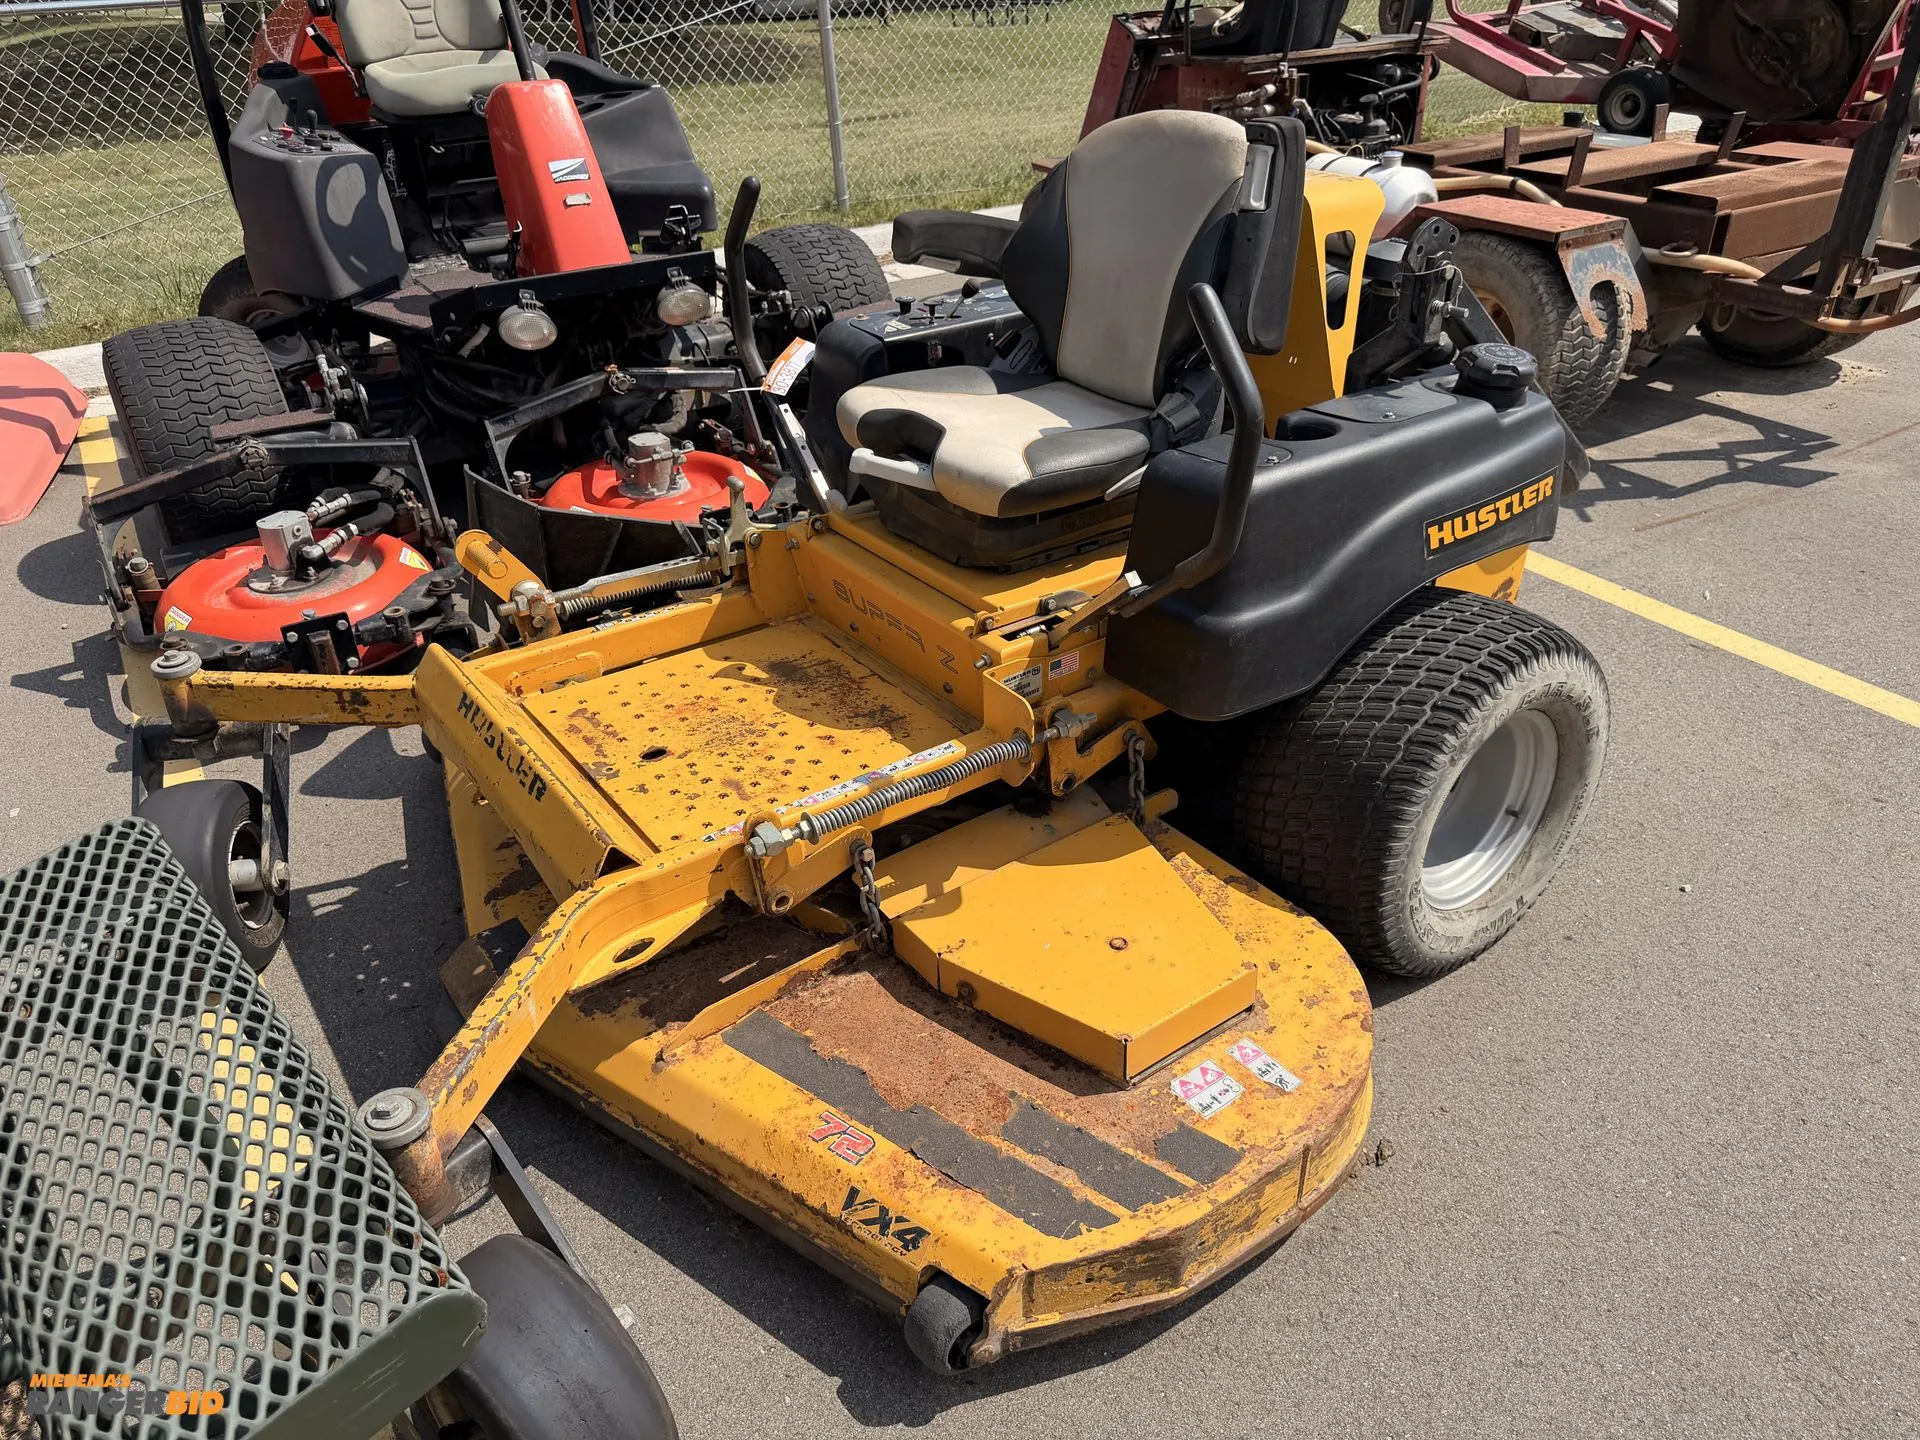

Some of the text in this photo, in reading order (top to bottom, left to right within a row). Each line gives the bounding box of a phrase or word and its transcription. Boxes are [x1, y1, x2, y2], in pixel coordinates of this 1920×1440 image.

[1427, 475, 1555, 551] HUSTLER
[936, 645, 959, 675] Z
[808, 1110, 876, 1166] 72
[840, 1185, 932, 1253] VX4
